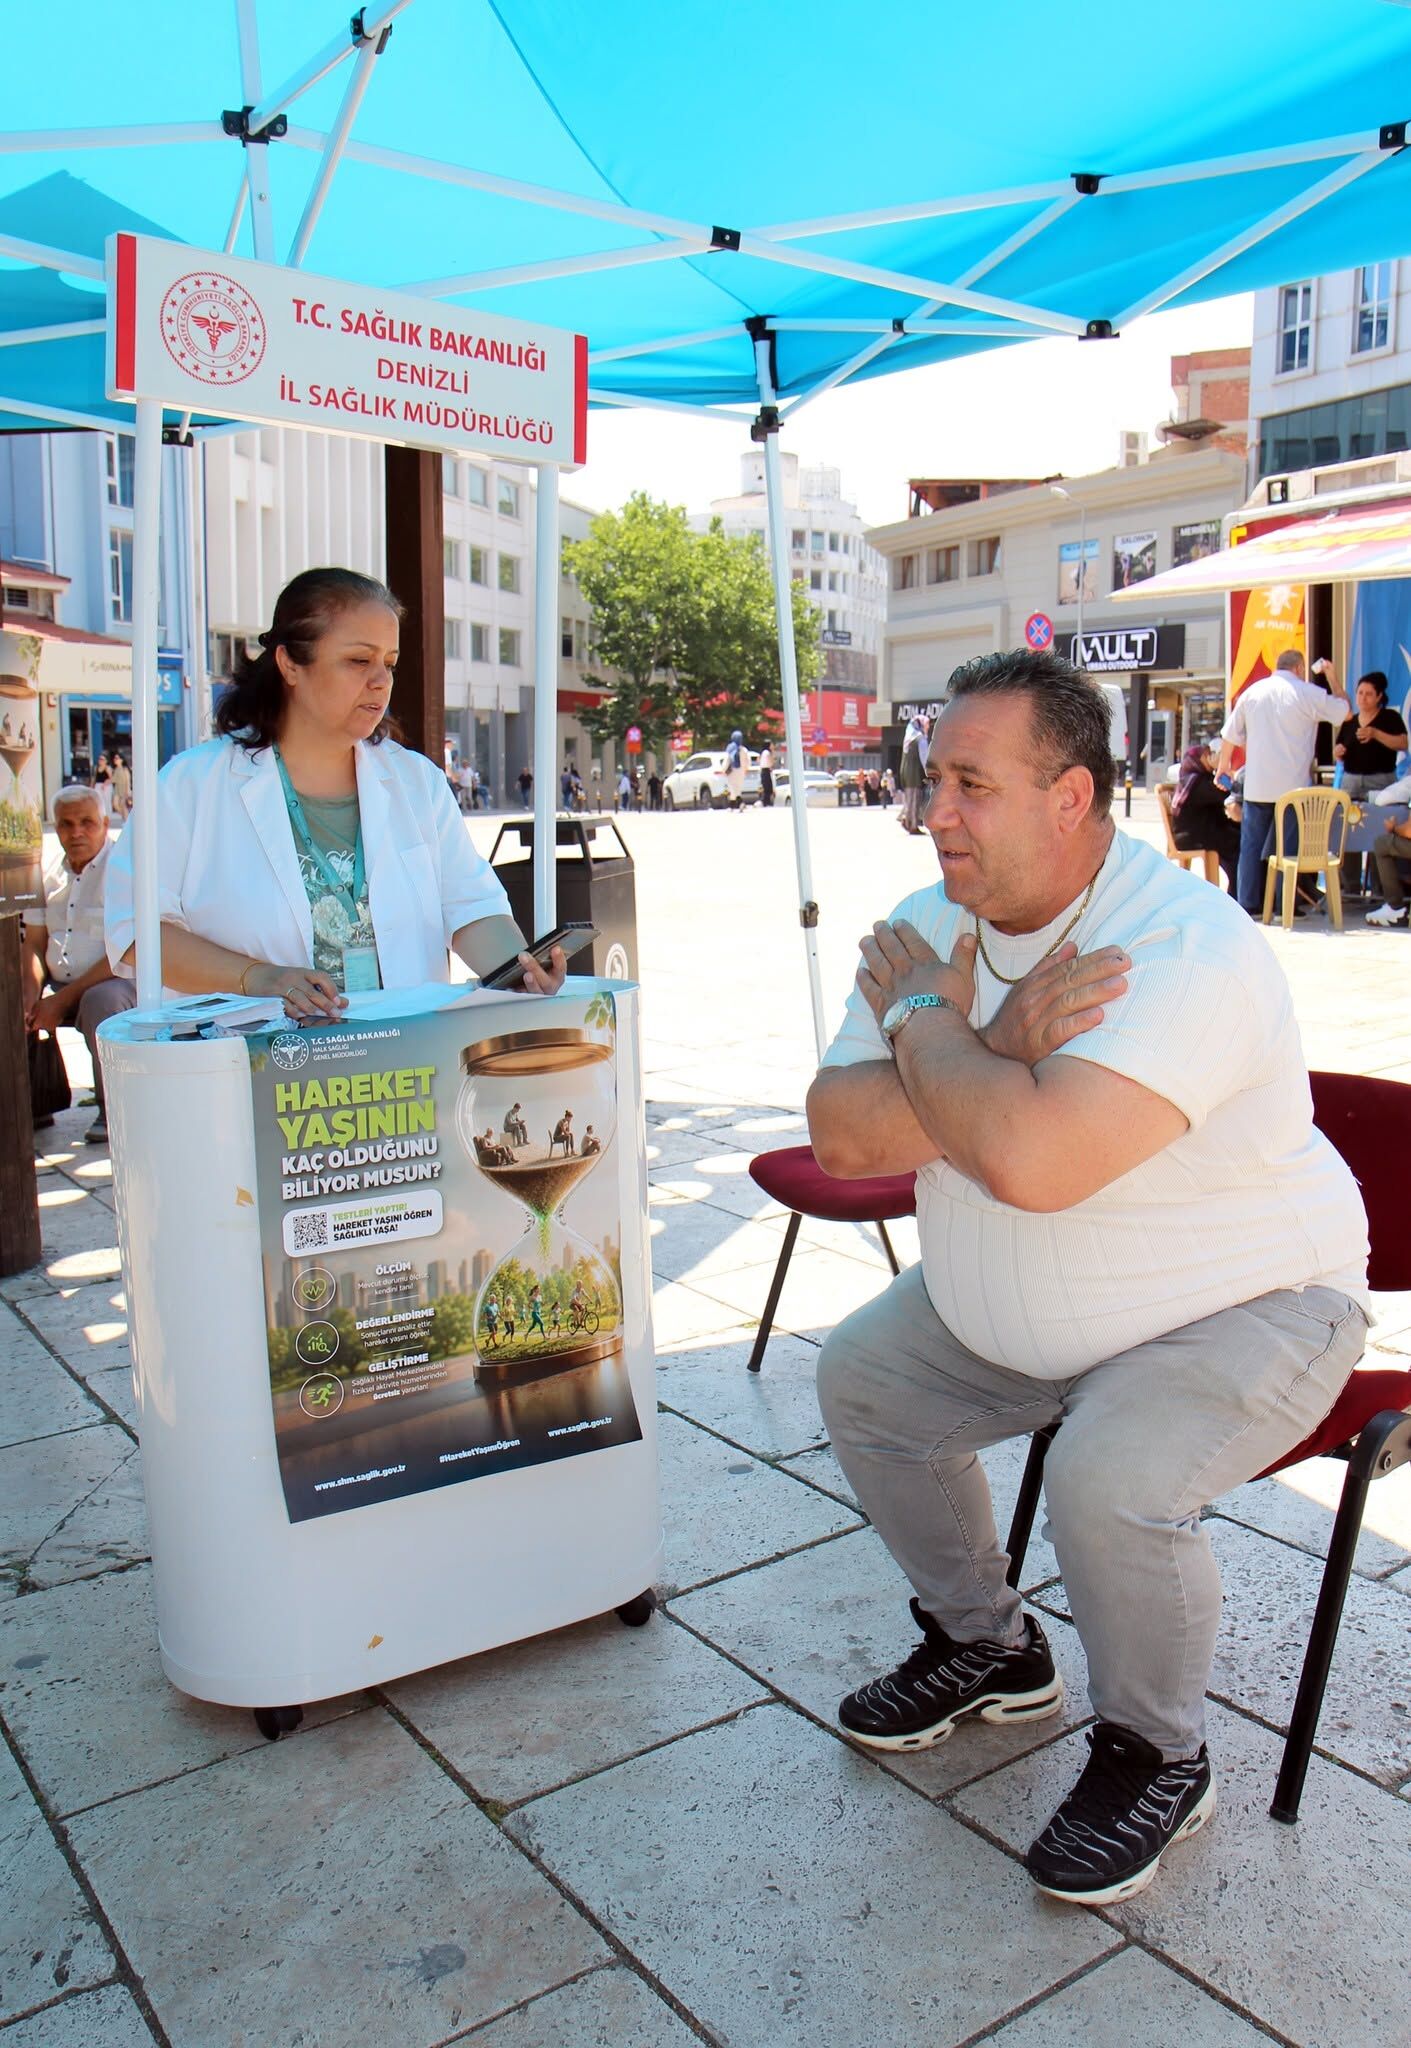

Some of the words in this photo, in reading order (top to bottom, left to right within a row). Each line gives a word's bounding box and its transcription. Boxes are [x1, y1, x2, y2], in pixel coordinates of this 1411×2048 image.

[292, 298, 331, 329] T.C.
[340, 307, 422, 348] SAĞLIK
[429, 326, 546, 371] BAKANLIĞI
[377, 357, 469, 394] DENİZLİ
[280, 374, 301, 402] İL
[309, 382, 397, 419] SAĞLIK
[404, 401, 554, 445] MÜDÜRLÜĞÜ
[1081, 632, 1150, 663] VAULT
[326, 1033, 356, 1044] SAĞLIK
[357, 1028, 400, 1040] BAKANLIĞI
[313, 1053, 332, 1061] GENEL
[275, 1066, 435, 1113] HAREKET
[277, 1100, 435, 1150] YAŞININ
[282, 1153, 324, 1175] KAÇ
[328, 1137, 438, 1169] OLDUĞUNU
[282, 1173, 360, 1200] BİLİYOR
[364, 1161, 442, 1188] MUSUN?
[332, 1208, 373, 1221] TESTLERİ
[333, 1218, 373, 1232] HAREKET
[374, 1214, 402, 1226] YAŞINI
[404, 1208, 433, 1221] ÖĞREN
[333, 1228, 372, 1241] SAĞLIKLI
[372, 1224, 398, 1236] YAŞA!
[375, 1261, 411, 1276] ÖLÇÜM
[356, 1308, 435, 1330] DEĞERLENDİRME
[397, 1322, 417, 1332] analiz
[364, 1338, 389, 1348] hareket
[369, 1353, 429, 1373] GELİŞTİRME
[376, 1372, 395, 1382] Hayat
[548, 1416, 613, 1438] www.saglik.gov.tr
[439, 1439, 521, 1463] #HareketYaşınıÖğren
[314, 1464, 406, 1492] www.shm.saglik.gov.tr
